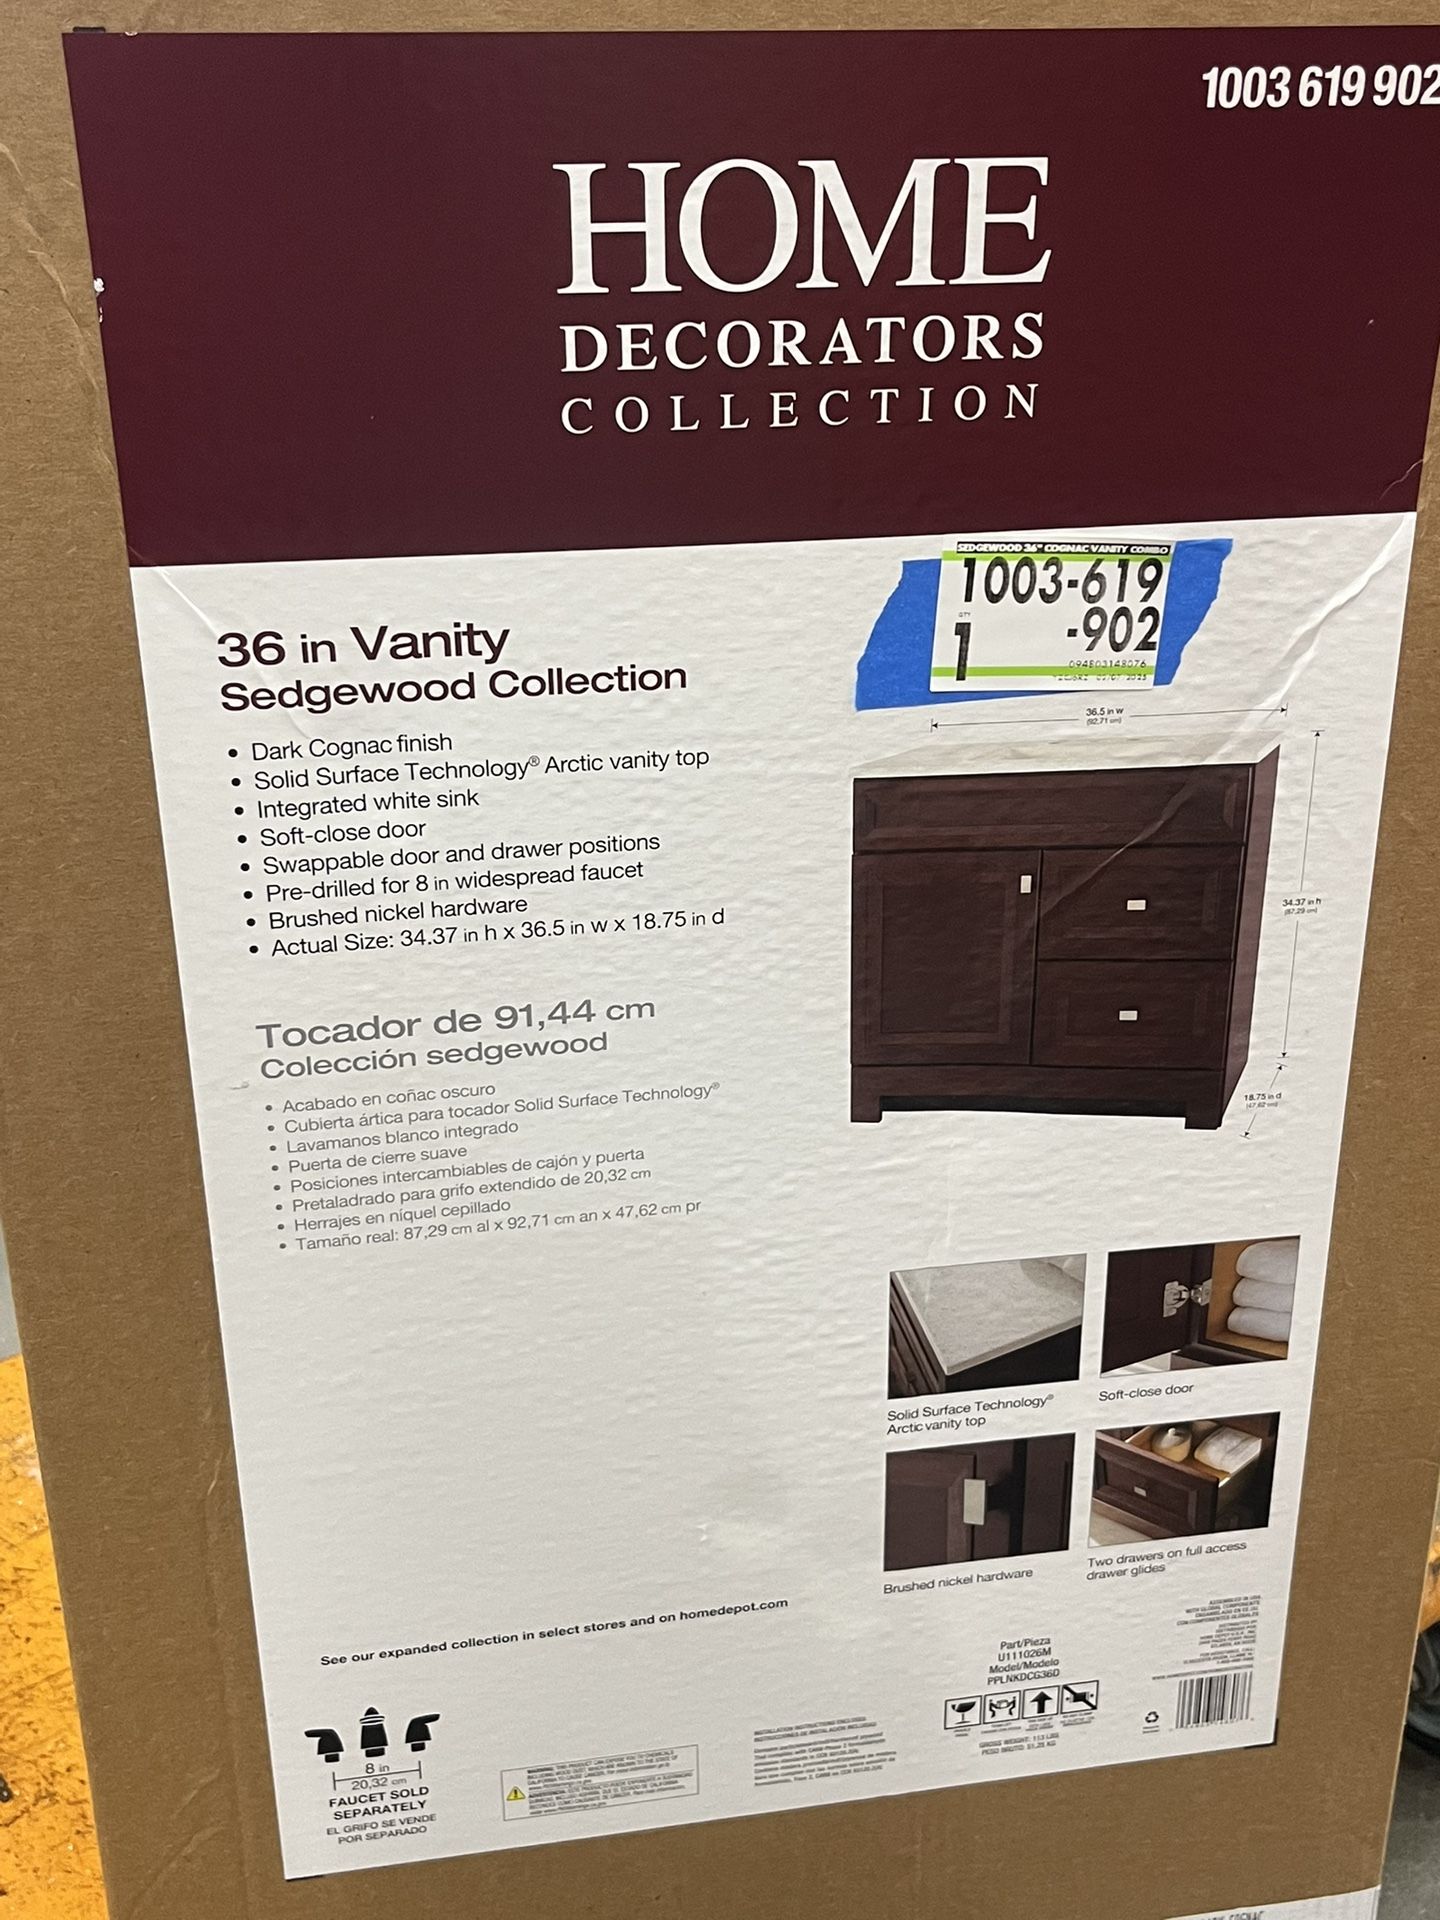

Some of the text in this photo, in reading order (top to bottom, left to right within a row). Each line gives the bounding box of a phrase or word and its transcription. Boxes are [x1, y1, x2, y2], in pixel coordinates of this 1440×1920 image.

[1202, 64, 1440, 108] 1003 619 902
[551, 156, 1052, 295] HOME
[559, 312, 1045, 374] DECORATORS
[560, 382, 1040, 435] COLLECTION
[957, 543, 1169, 554] SEDGEWOOD COGNAC VANITY COMBO
[963, 556, 1164, 604] 1003-619
[218, 622, 510, 667] 36 in Vanity
[1067, 606, 1160, 652] -902
[955, 622, 971, 681] 1
[221, 664, 687, 714] Sedgewood Collection
[1086, 707, 1105, 716] 36.5
[252, 733, 452, 760] Dark Cognac finish
[254, 769, 309, 789] Solid
[316, 766, 399, 786] Surface
[545, 754, 604, 773] Arctic
[610, 751, 669, 771] vanity
[676, 749, 709, 768] top
[258, 789, 479, 820] Integrated white sink
[261, 821, 426, 846] Soft-close door
[264, 835, 660, 875] Swappable door and drawer positions
[267, 862, 644, 901] Pre-drilled for 8 in widespread faucet
[269, 898, 528, 929] Brushed nickel hardware
[1282, 899, 1305, 907] 34.37
[272, 908, 725, 956] Actual Size: 34.37 in h x 36.5 in w x 18.75 in d
[255, 999, 655, 1048] Tocador de 91,44 cm
[261, 1032, 607, 1079] Colección sedgewood
[283, 1085, 495, 1113] Acabado en coñac oscuro
[1244, 1093, 1266, 1101] 18.75
[285, 1093, 617, 1133] Cubierta ártica para tocador Solid Surface
[287, 1122, 518, 1153] Lavamanos blanco integrado
[289, 1147, 467, 1173] Puerta de cierre suave
[291, 1149, 644, 1192] Posiciones intercambiables de cajón puerta
[292, 1168, 651, 1212] Pretaladrado para grifo extendido de 20,32 cm
[295, 1201, 511, 1232] Herrajes en níquel cepillado
[296, 1204, 657, 1250] Tamaño real: 87,29 92,71 47,62
[1099, 1382, 1194, 1401] Soft-close door
[887, 1403, 971, 1421] Solid Surface
[887, 1415, 986, 1435] Arctic vanity top
[1087, 1542, 1247, 1568] Two drawers on full access
[883, 1568, 1033, 1594] Brushed nickel hardware
[1087, 1563, 1165, 1581] drawer glides
[320, 1598, 788, 1666] See our expanded collection in select stores and on homedepot.com
[1000, 1637, 1050, 1650] Part/Pieza
[989, 1659, 1059, 1673] Model/Modelo
[352, 1777, 407, 1790] 20,32 cm
[365, 1763, 389, 1774] 8 in
[330, 1787, 429, 1807] FAUCET SOLD
[334, 1800, 427, 1820] SEPARATELY
[338, 1826, 427, 1844] POR SEPARADO
[344, 1821, 378, 1833] GRIFO
[382, 1819, 396, 1828] SE
[399, 1814, 436, 1825] VENDE
